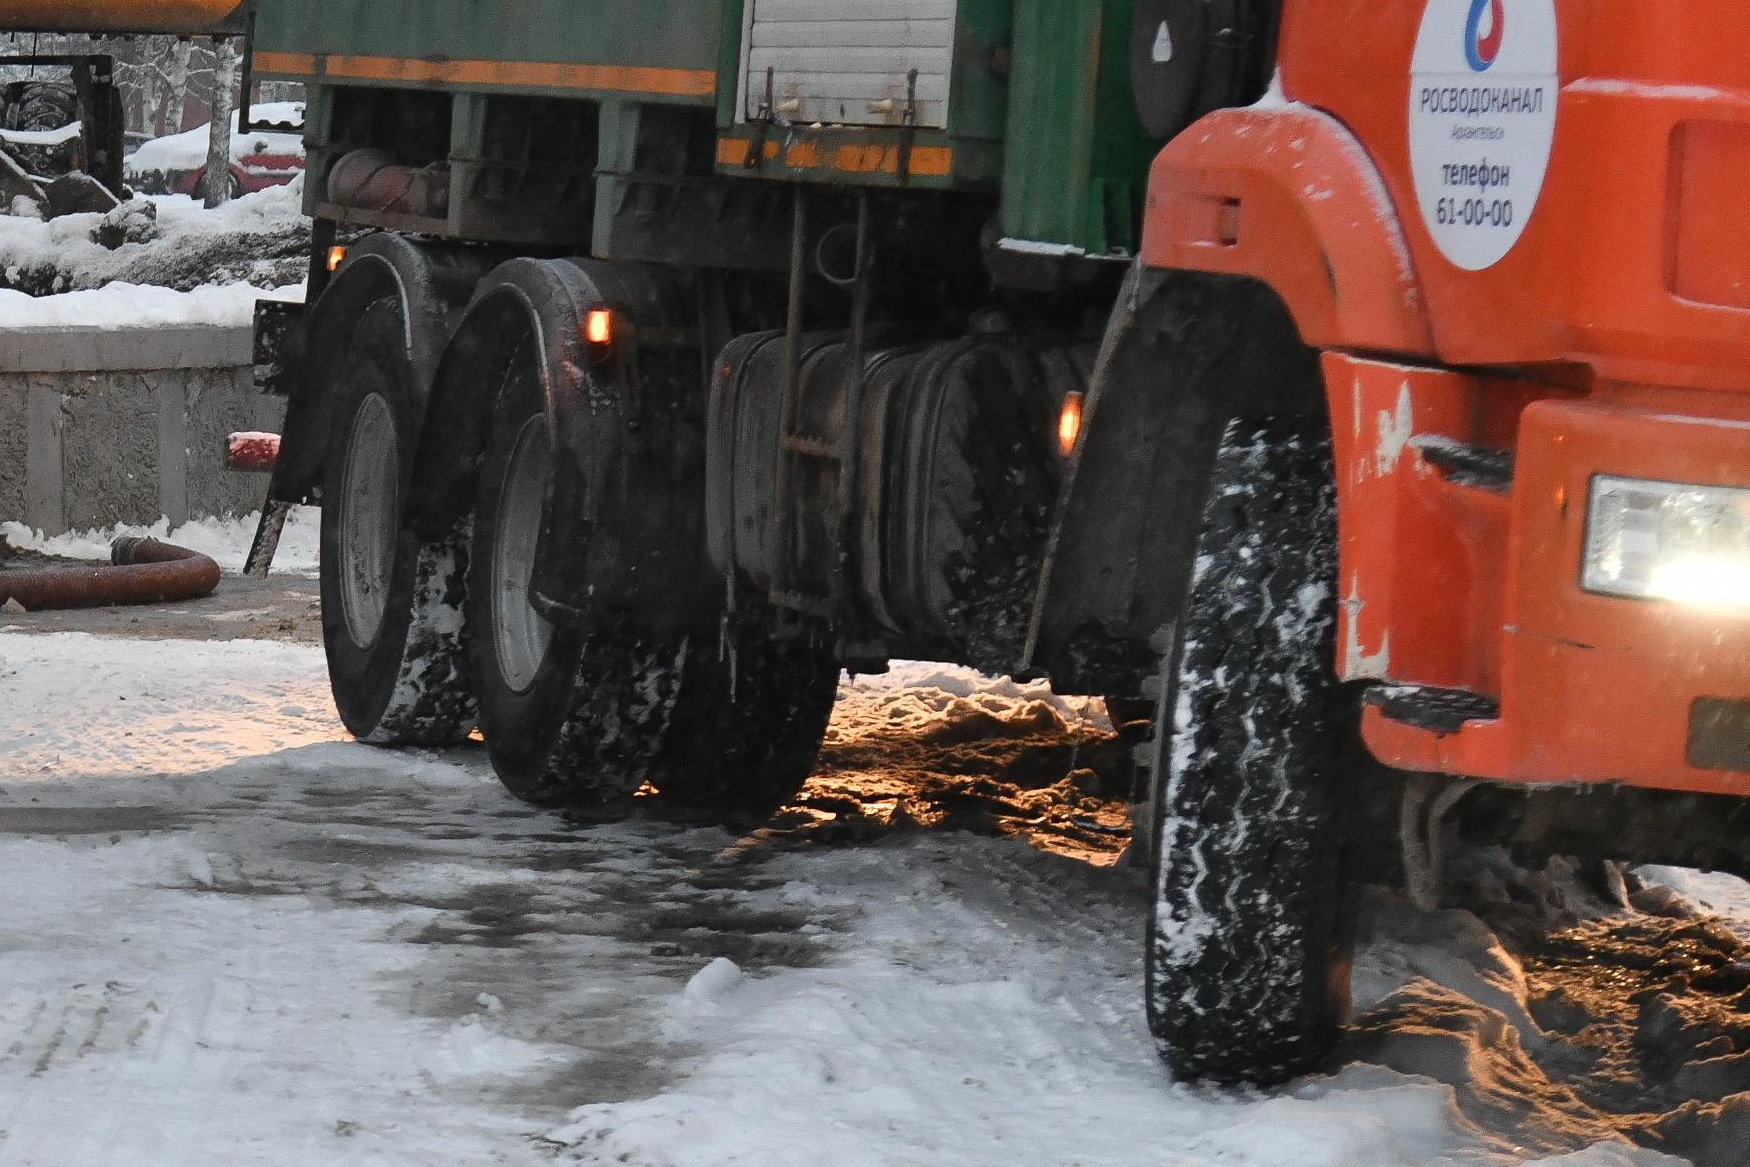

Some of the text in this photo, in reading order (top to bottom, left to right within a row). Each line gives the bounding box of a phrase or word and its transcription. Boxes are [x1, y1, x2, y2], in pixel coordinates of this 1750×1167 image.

[1421, 87, 1543, 117] РОСВОДОКАНАЛ
[1442, 157, 1510, 193] телефон
[1437, 196, 1513, 227] 61-00-00
